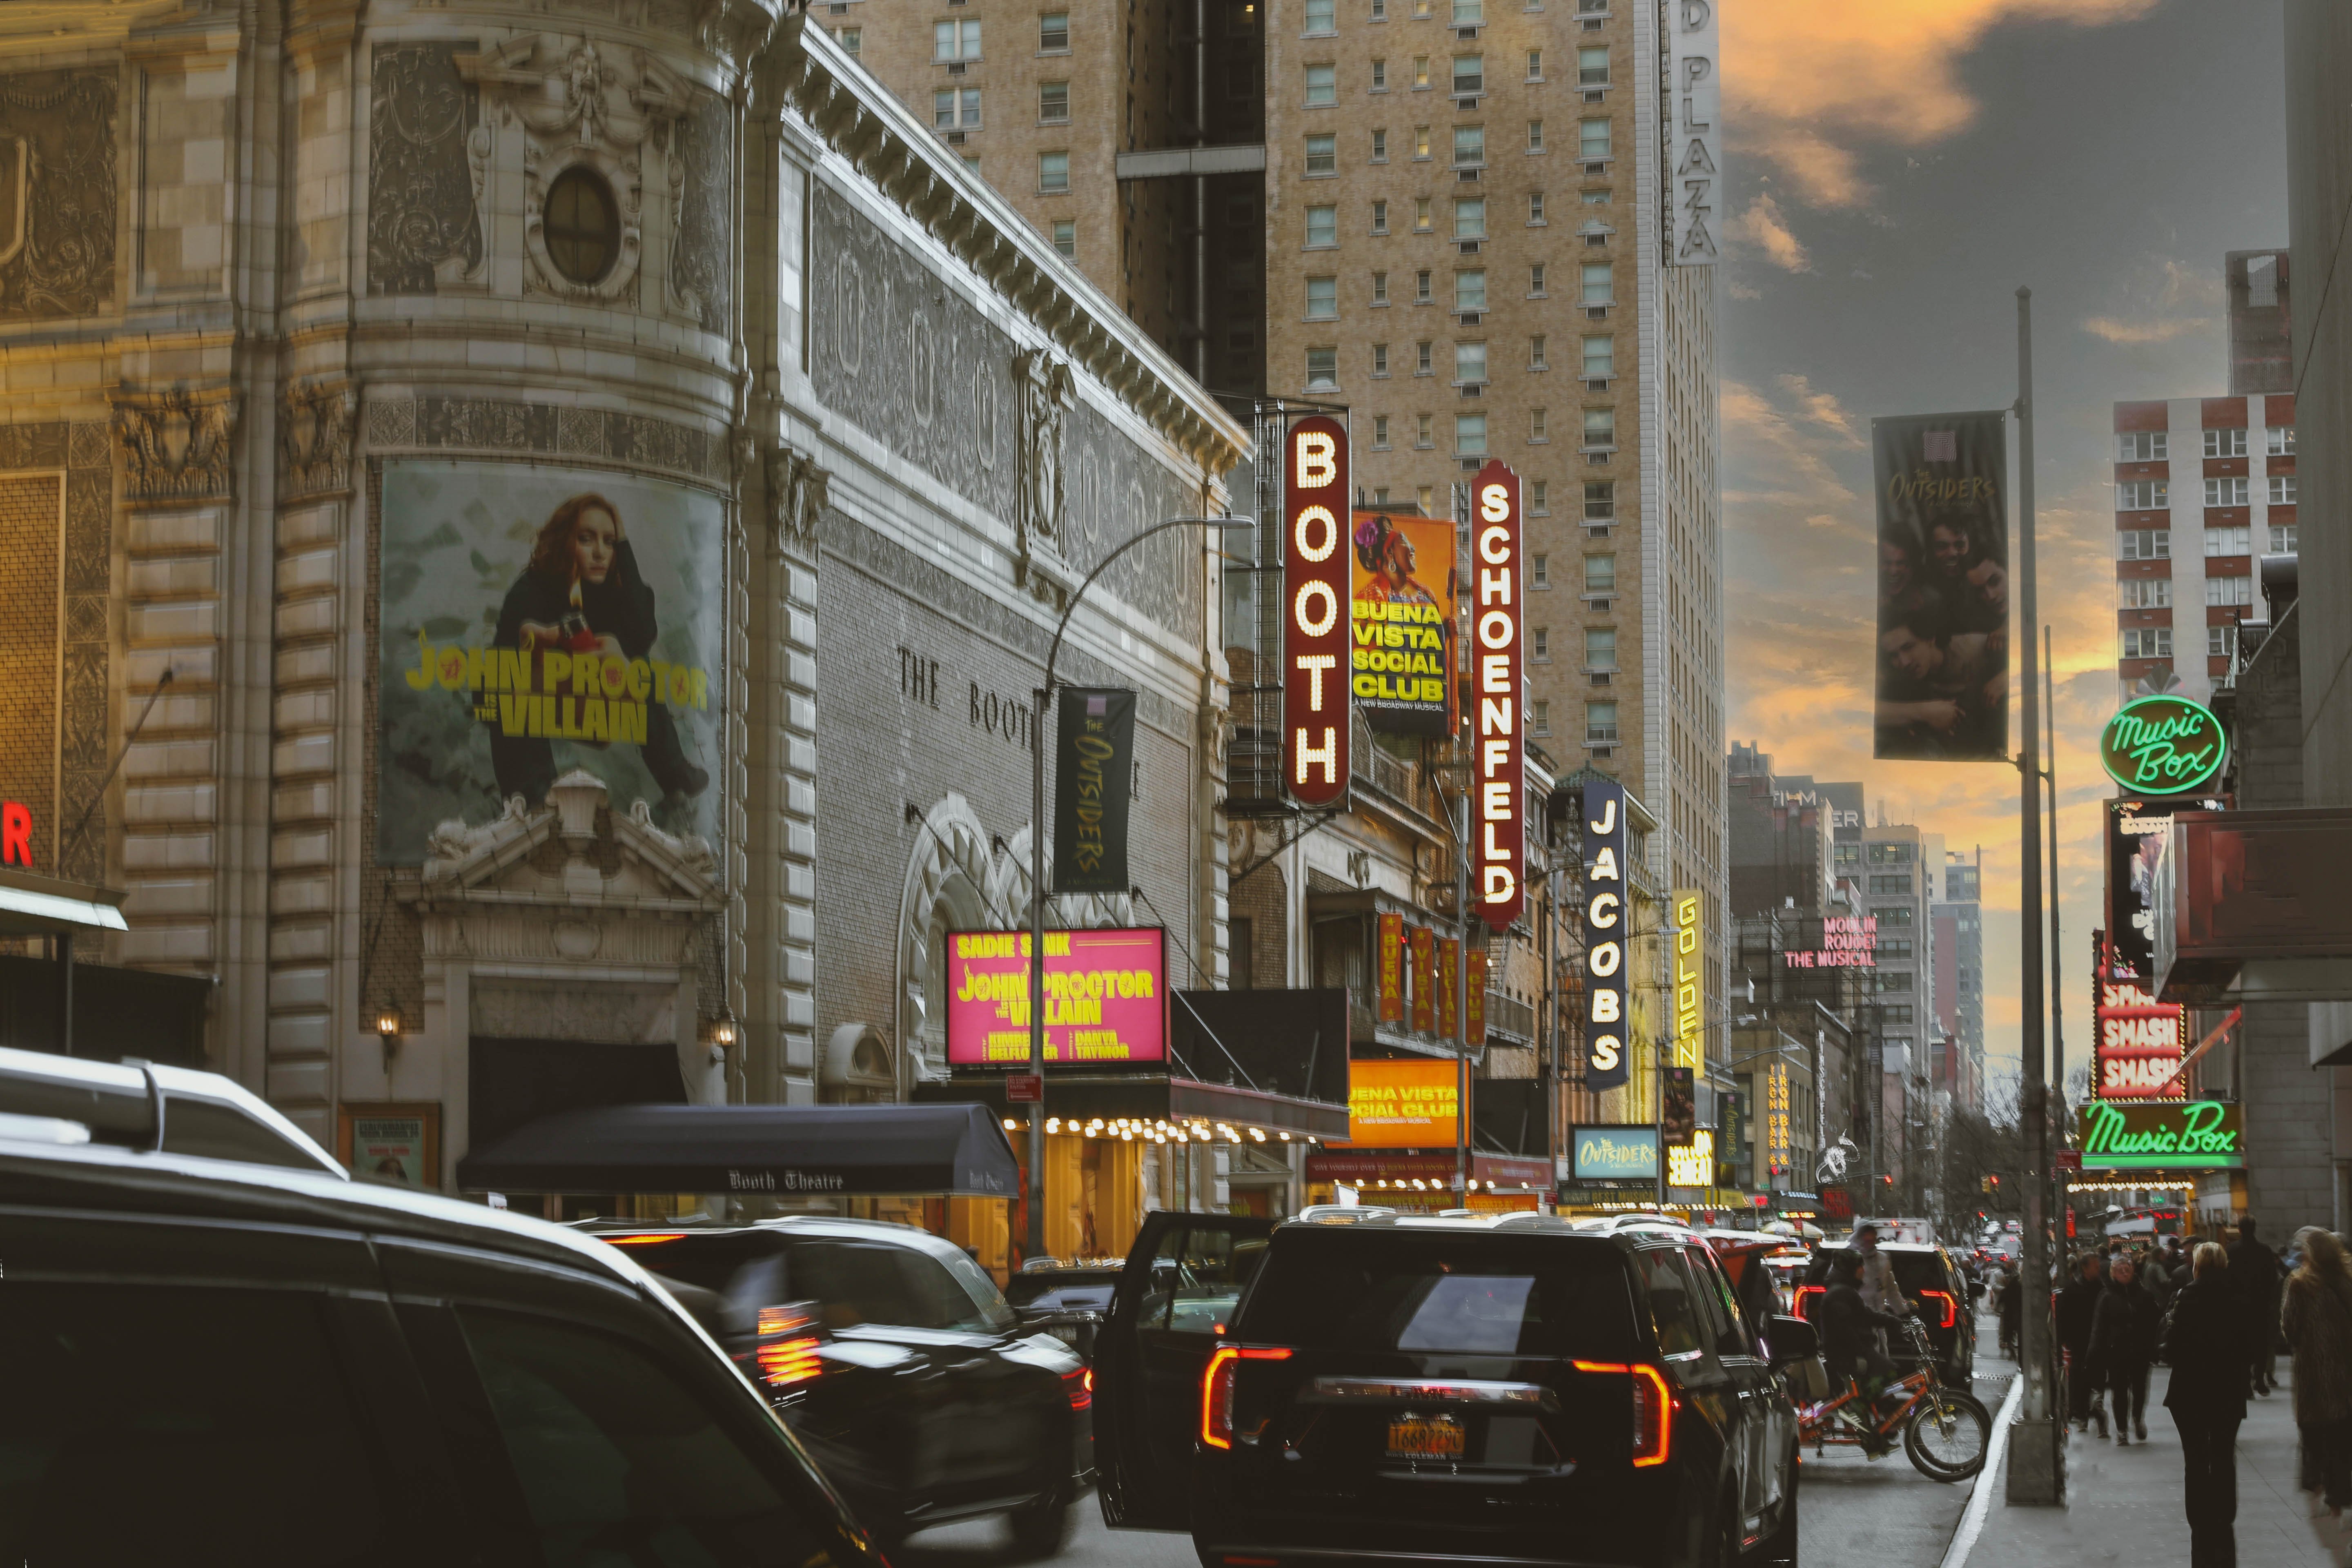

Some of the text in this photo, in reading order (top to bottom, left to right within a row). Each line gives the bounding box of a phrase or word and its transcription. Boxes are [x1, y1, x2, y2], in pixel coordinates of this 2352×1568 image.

[1677, 56, 1718, 257] PLAZA
[1888, 473, 1996, 503] OUTSIDERS
[1294, 432, 1337, 784] BOOTH
[1352, 601, 1442, 625] BUENA
[1352, 622, 1443, 651] VISTA
[405, 626, 707, 711] JOHN PROCTOR
[1352, 649, 1443, 675] SOCIAL
[898, 647, 940, 708] THE
[1352, 673, 1445, 702] CLUB
[1361, 699, 1376, 708] NEW
[1377, 700, 1414, 709] BROADWAY
[1414, 702, 1444, 711] MUSICAL
[1479, 483, 1515, 904] SCHOENFELD
[474, 694, 647, 746] THE VILLAIN
[1085, 719, 1104, 733] THE
[2112, 707, 2204, 751] Music
[2129, 741, 2213, 782] Box
[1074, 736, 1114, 873] OUTSIDERS
[1589, 800, 1622, 1072] JACOBS
[1824, 916, 1877, 933] MOULIN
[957, 933, 1071, 960] SADIE SNK
[1824, 933, 1876, 950] ROUGE!
[1383, 934, 1398, 999] BUENA
[1784, 950, 1876, 967] THE MUSICAL
[957, 963, 1029, 1002] JOHN
[1416, 948, 1429, 1010] VISTA
[1444, 954, 1455, 1023] SOCIAL
[1679, 896, 1696, 1068] GOLDEN
[1469, 974, 1481, 1020] CLUB
[988, 1031, 1050, 1047] KIMBEY
[1075, 1029, 1118, 1046] DANYA
[2103, 1017, 2178, 1047] SMASH
[989, 1043, 1058, 1061] BELFLOER
[1076, 1043, 1129, 1060] TAYMOR
[1399, 1086, 1458, 1101] VISTA
[1778, 1063, 1789, 1165] IRON BAR &
[2086, 1100, 2236, 1152] Music Box
[1330, 1163, 1359, 1171] YOURSELF
[1361, 1163, 1376, 1171] OVER
[1378, 1163, 1385, 1171] TO
[1580, 1140, 1657, 1166] OUTSIDERS
[729, 1169, 843, 1190] Booth Theatre
[1423, 1195, 1452, 1205] BEGIN
[1592, 1190, 1615, 1203] BEST
